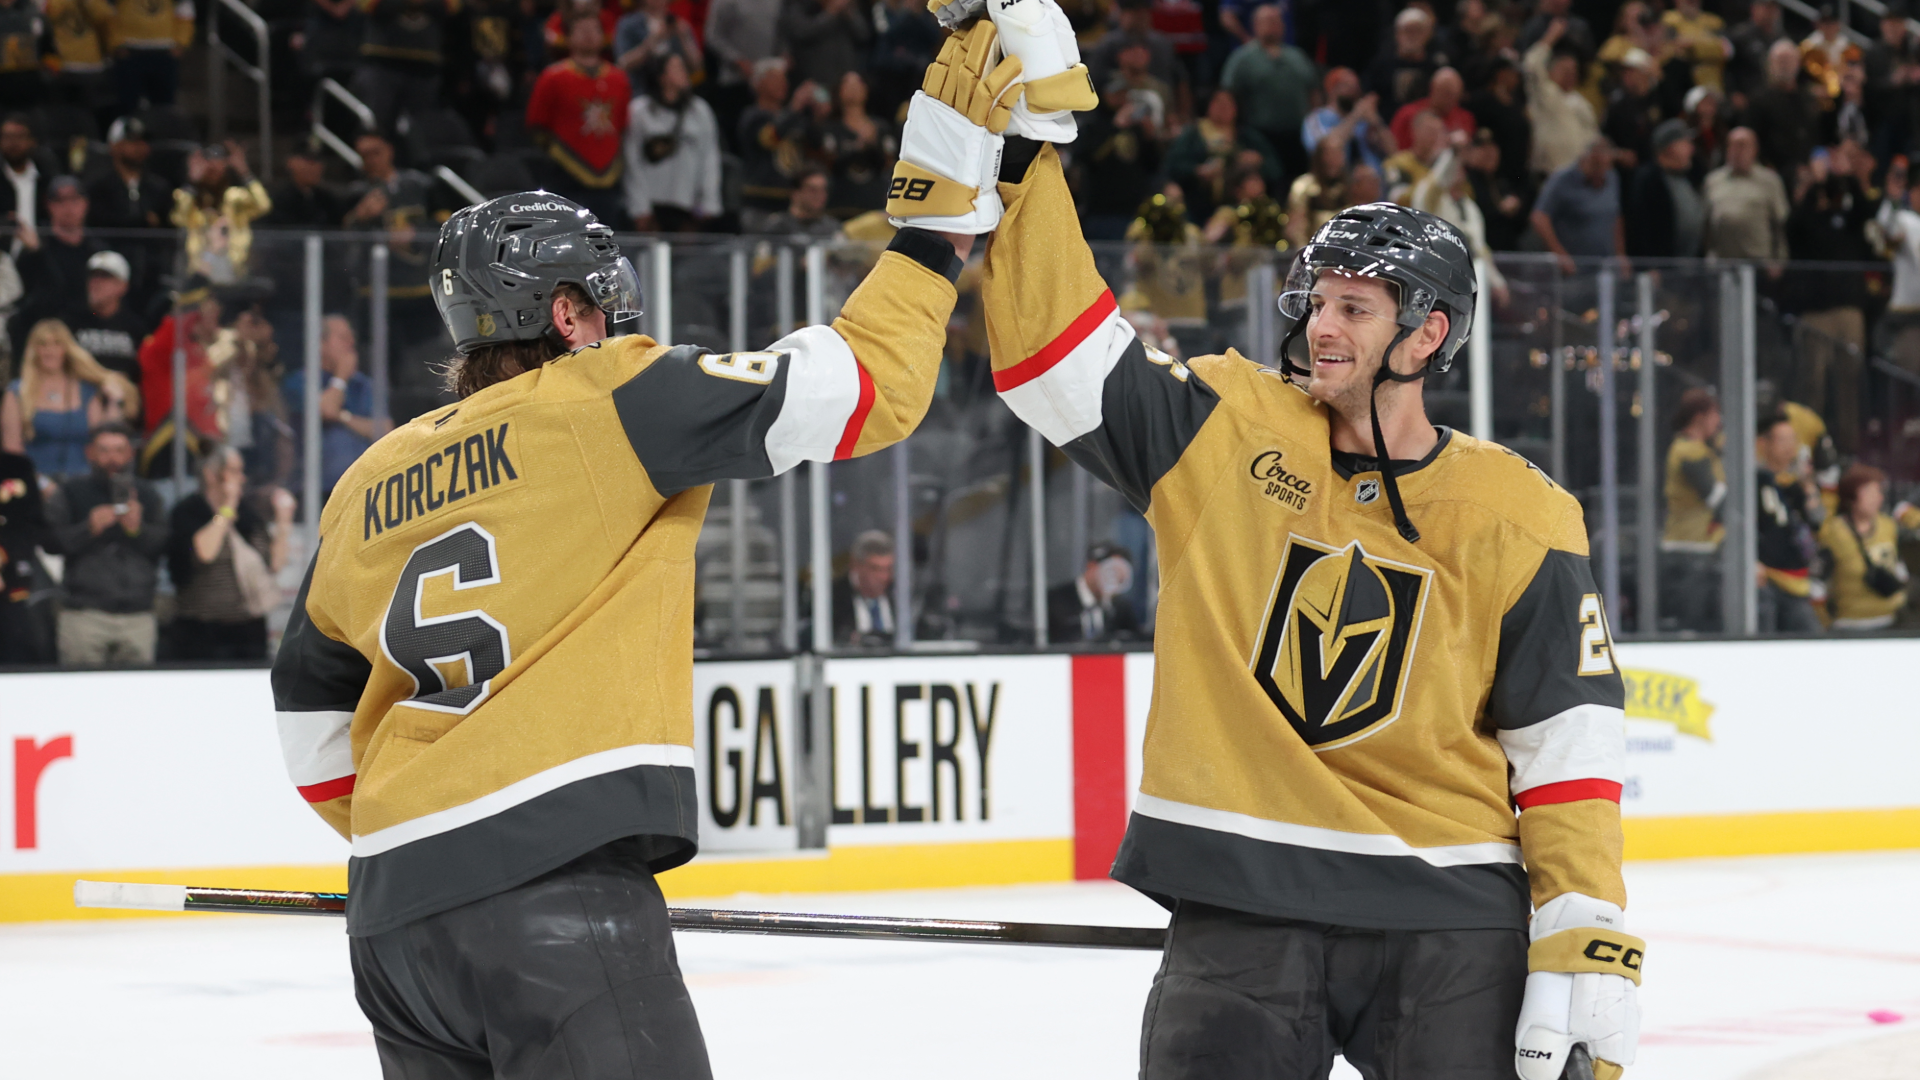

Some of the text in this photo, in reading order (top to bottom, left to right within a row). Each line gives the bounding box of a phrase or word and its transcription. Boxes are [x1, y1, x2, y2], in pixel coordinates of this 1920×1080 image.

[442, 268, 453, 296] 6
[364, 422, 518, 541] KORCZAK
[1250, 451, 1311, 494] Circa
[1265, 481, 1306, 511] SPORTS
[379, 520, 512, 715] 6
[1577, 593, 1620, 676] 2
[708, 682, 1000, 829] GALLERY
[1583, 938, 1644, 973] CC
[1519, 1048, 1552, 1060] CCM
